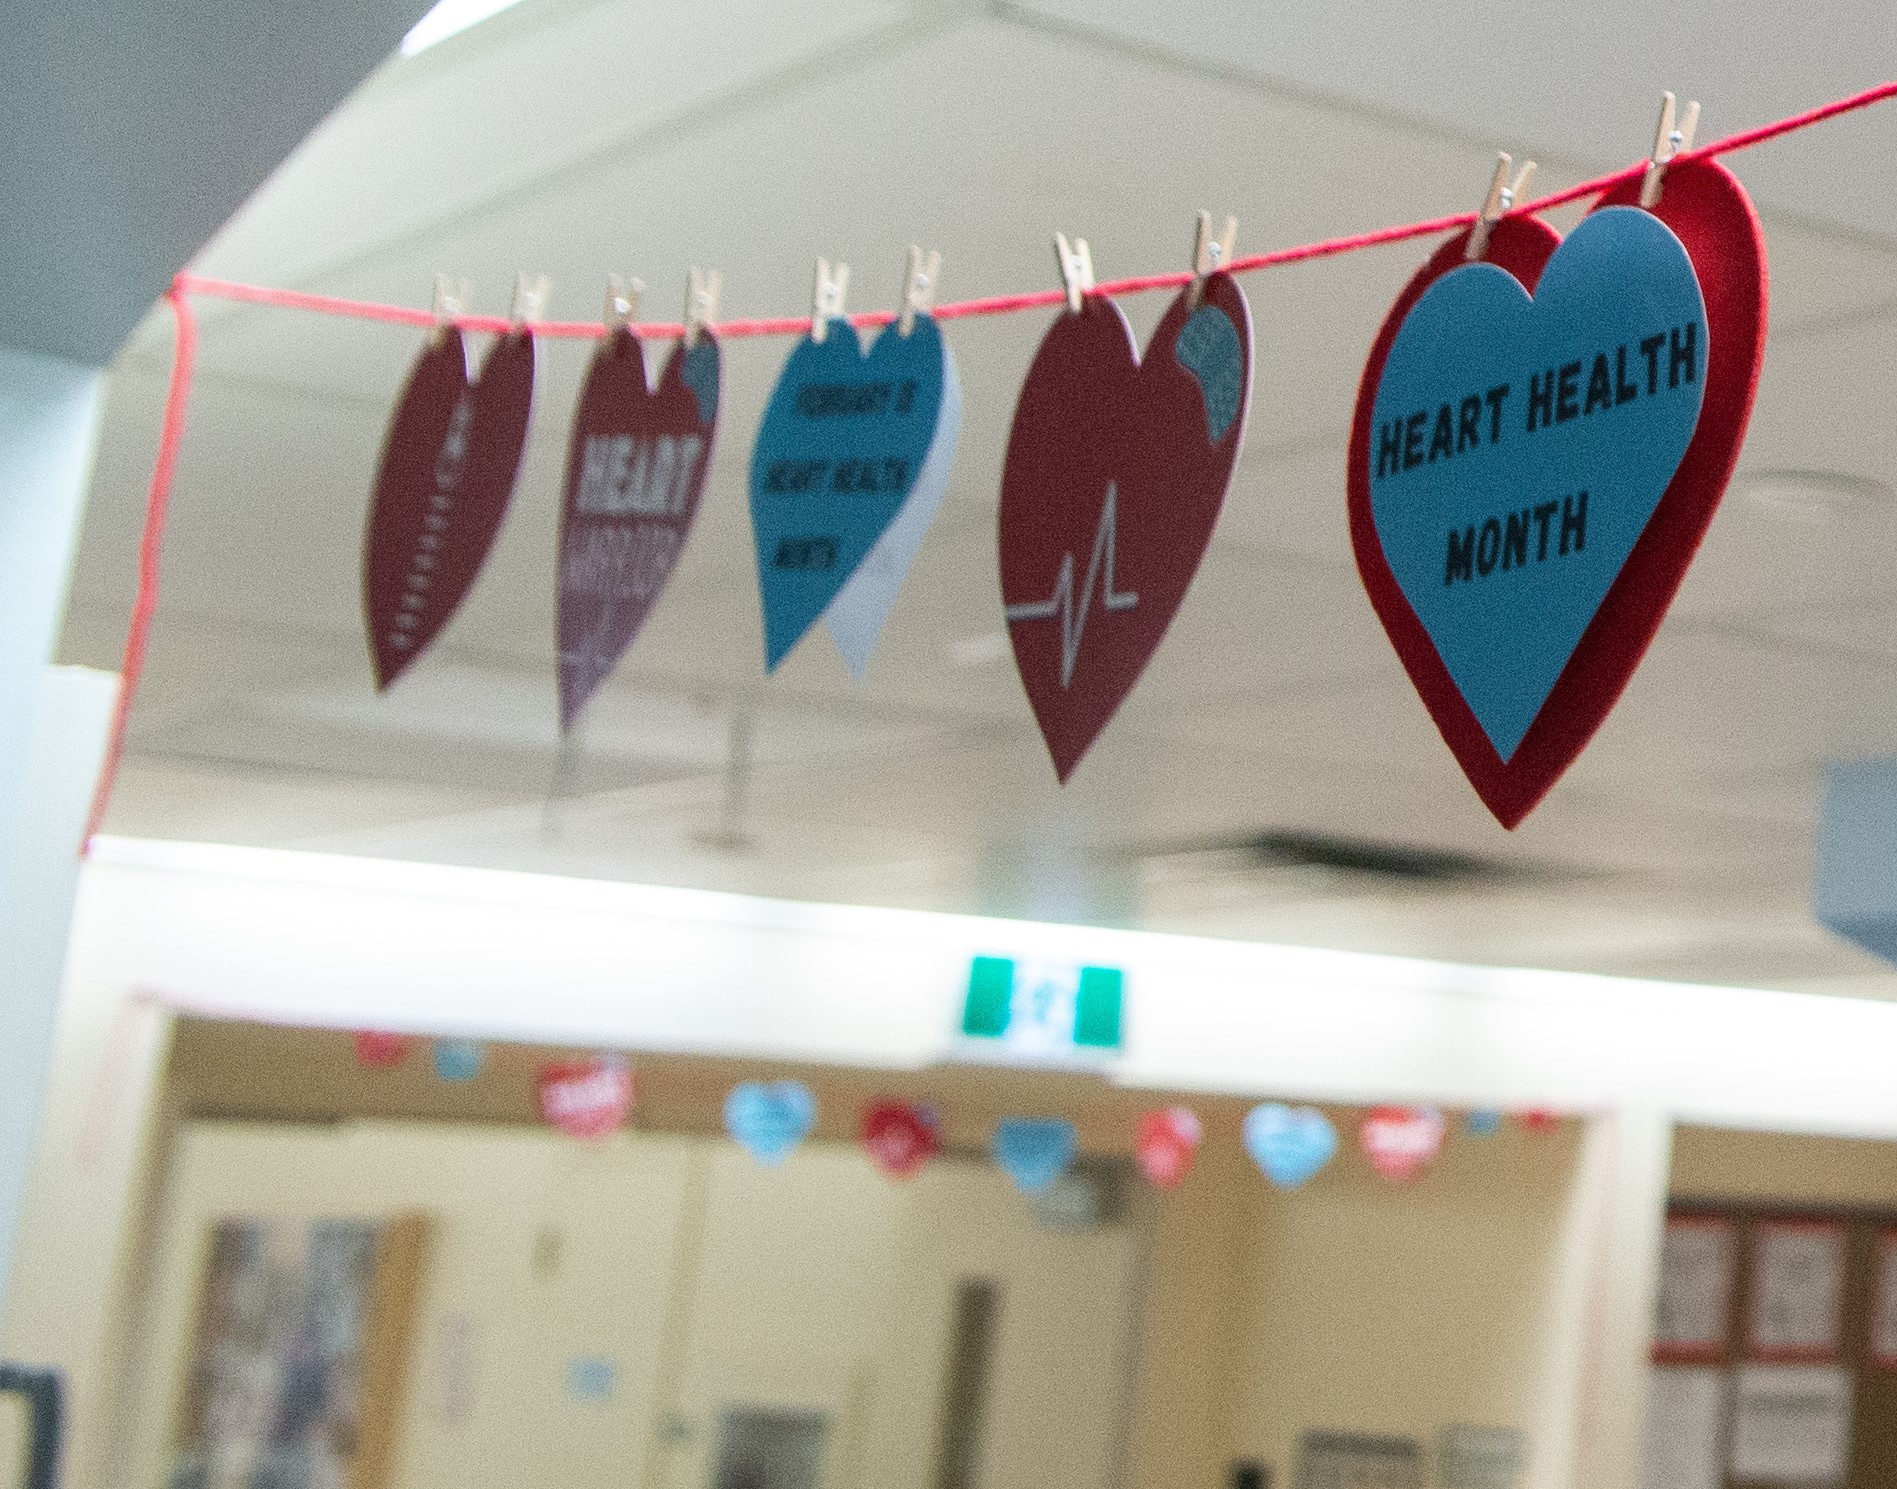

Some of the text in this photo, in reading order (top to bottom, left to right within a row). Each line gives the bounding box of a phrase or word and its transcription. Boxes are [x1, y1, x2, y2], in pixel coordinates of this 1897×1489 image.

[1376, 322, 1698, 478] HEART HEALTH
[577, 434, 702, 515] HEART
[1444, 490, 1590, 586] MONTH
